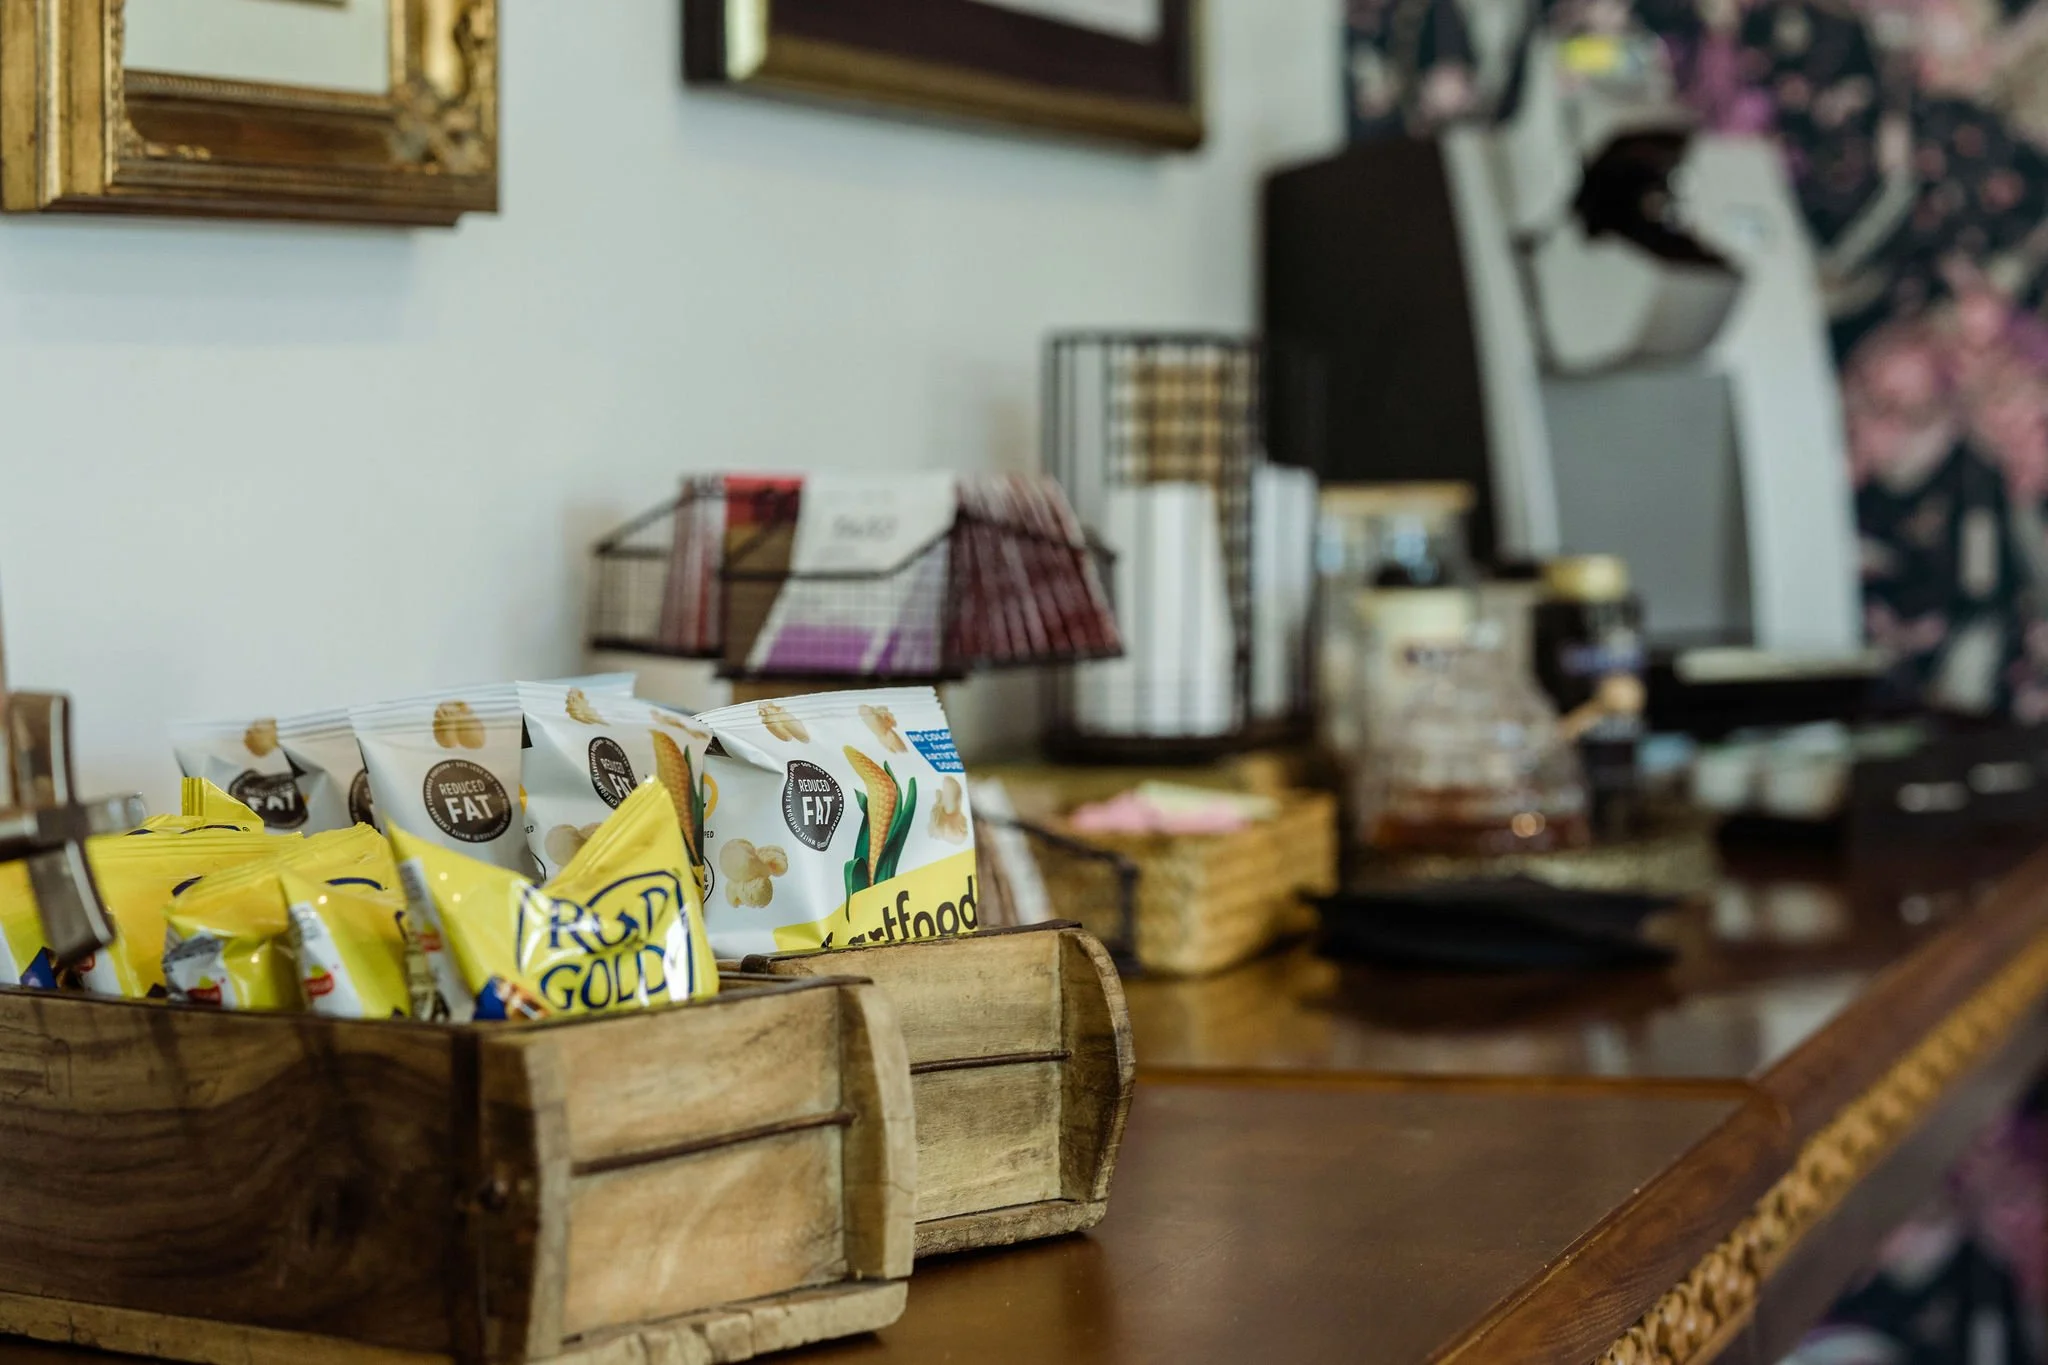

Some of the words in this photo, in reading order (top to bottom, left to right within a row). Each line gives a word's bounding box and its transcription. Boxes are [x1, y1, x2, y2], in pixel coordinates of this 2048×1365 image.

[438, 779, 486, 796] REDUCED
[798, 779, 831, 792] REDUCED
[444, 794, 493, 823] FAT
[802, 796, 833, 825] FAT
[539, 944, 669, 1010] GOLD
